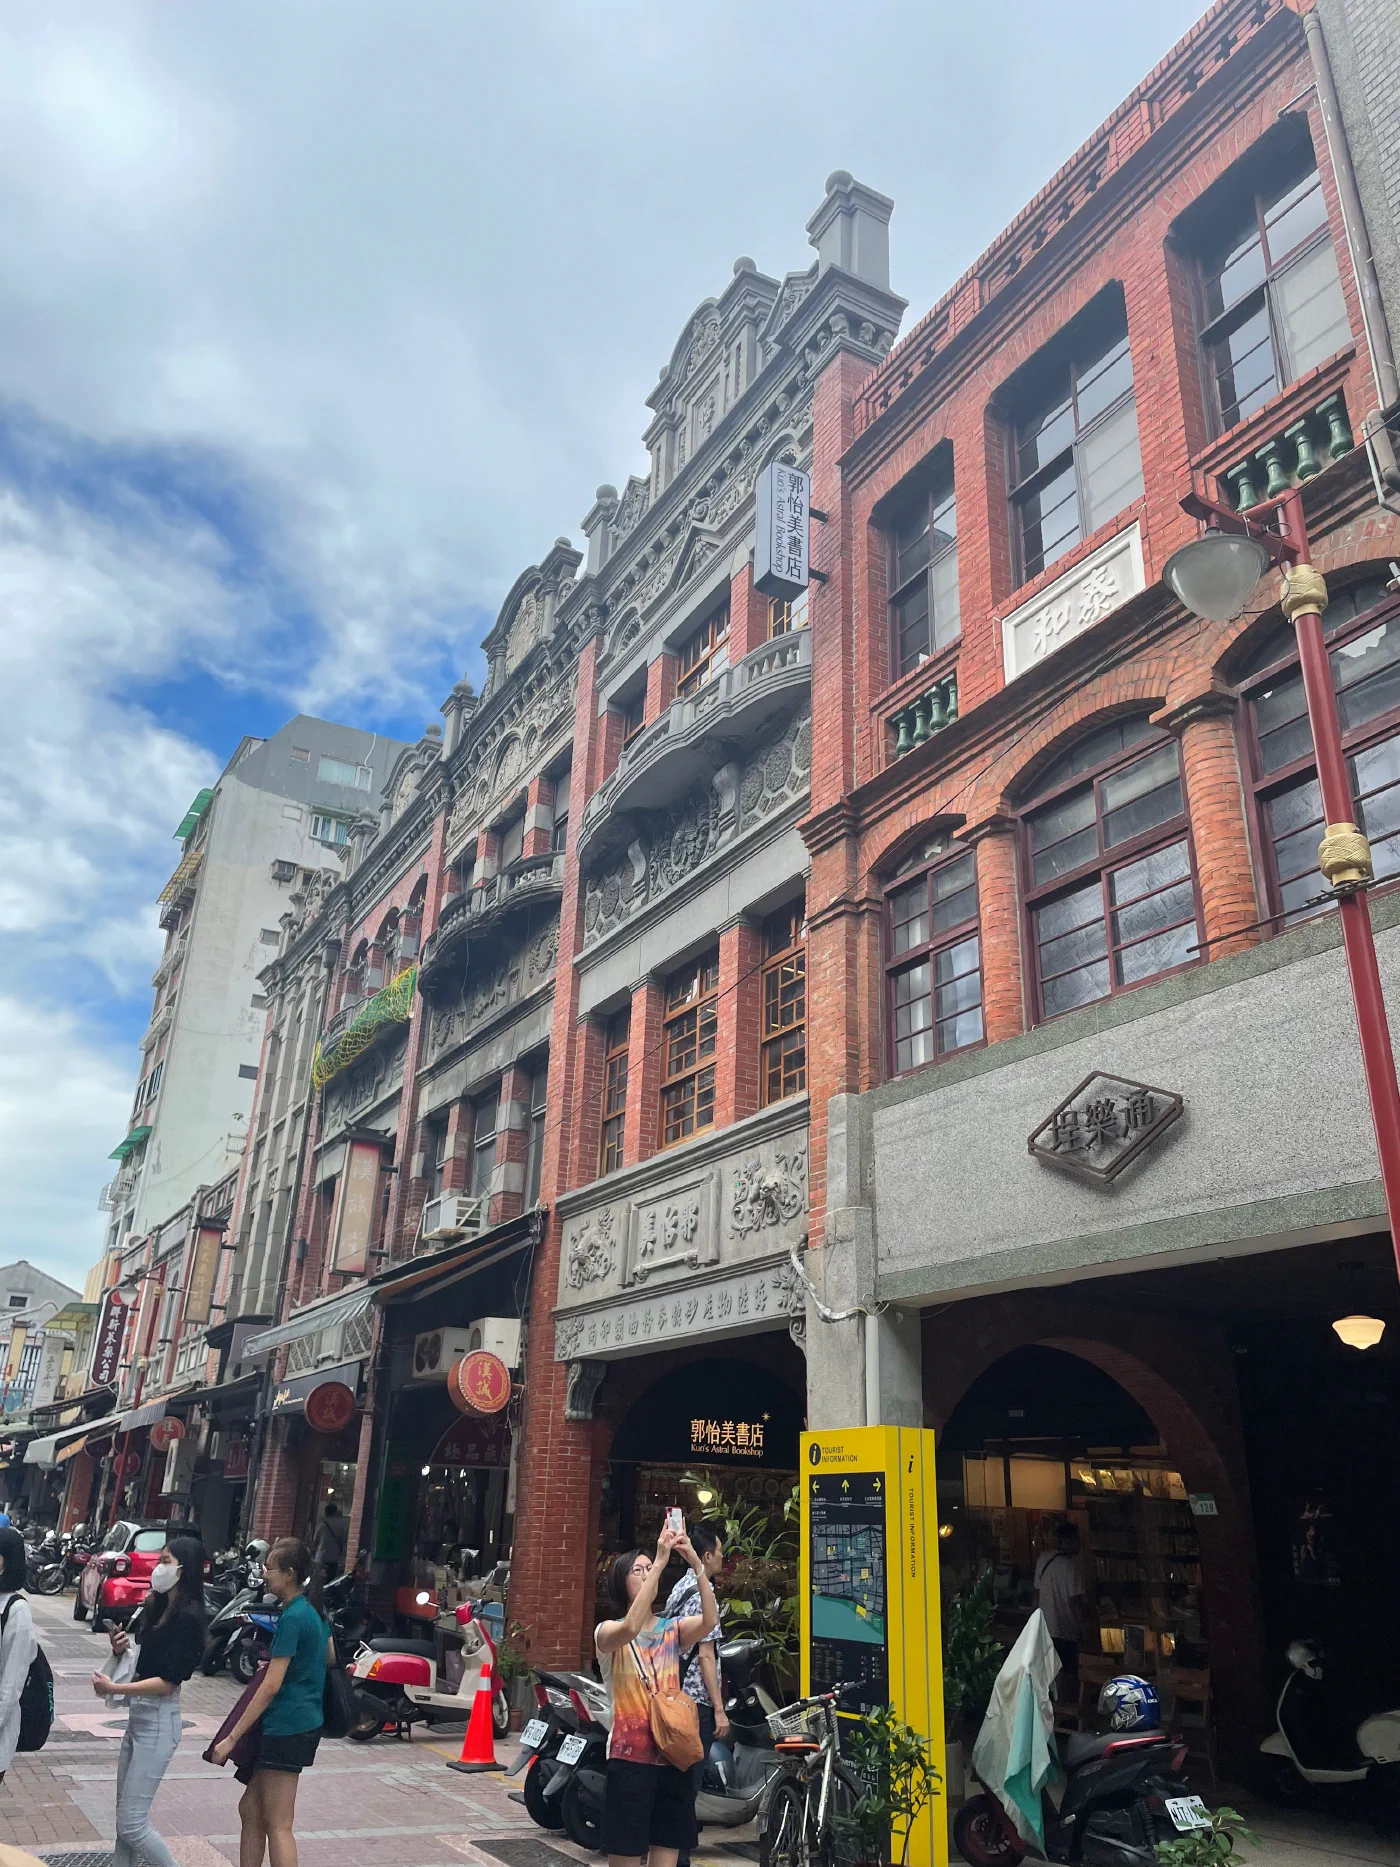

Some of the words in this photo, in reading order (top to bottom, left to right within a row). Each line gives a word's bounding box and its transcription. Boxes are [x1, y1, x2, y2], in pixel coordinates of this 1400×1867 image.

[776, 468, 786, 494] Kuo's
[776, 496, 786, 524] Astral
[785, 473, 804, 580] 郭怡美書店
[772, 525, 786, 573] Bookshop
[475, 1361, 494, 1401] 漢誠
[690, 1418, 764, 1448] 郭怡美書店
[690, 1444, 709, 1453] Kuo's
[711, 1445, 730, 1454] Astral
[731, 1446, 764, 1458] Bookshop
[821, 1446, 844, 1454] TOURIST
[821, 1454, 858, 1462] INFORMATION
